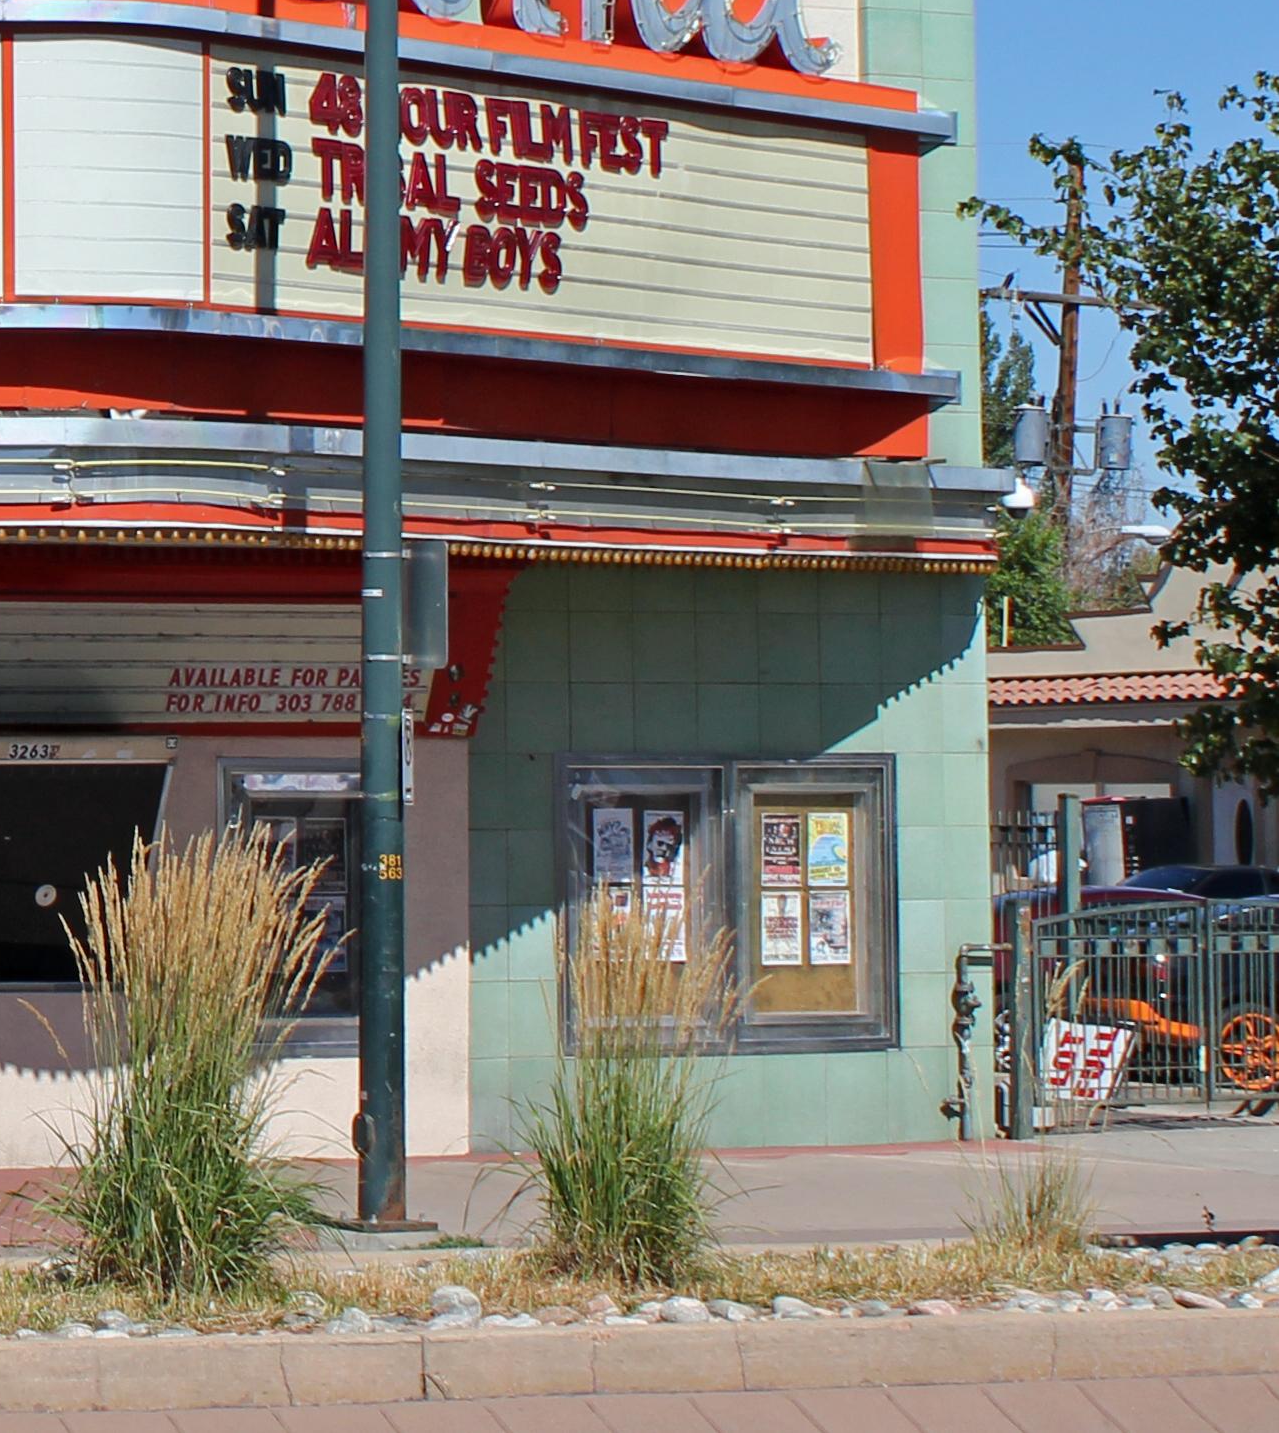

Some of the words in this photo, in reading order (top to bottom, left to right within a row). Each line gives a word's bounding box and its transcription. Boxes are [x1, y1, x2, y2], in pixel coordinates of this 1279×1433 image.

[226, 67, 286, 117] SUN
[309, 71, 363, 137] 48
[399, 87, 483, 153] OUR
[484, 96, 573, 166] FILM
[579, 108, 669, 179] FEST
[225, 134, 292, 187] WED
[311, 137, 460, 213] TRAL
[475, 159, 589, 232] SEEDS
[226, 202, 286, 252] SAT
[306, 207, 366, 272] AL
[463, 223, 563, 295] BOYS
[166, 694, 203, 712] FOR
[214, 694, 261, 713] INFO
[276, 694, 312, 713] 303
[321, 694, 356, 713] 788
[169, 668, 281, 687] AVAILABLE
[291, 669, 329, 687] FOR
